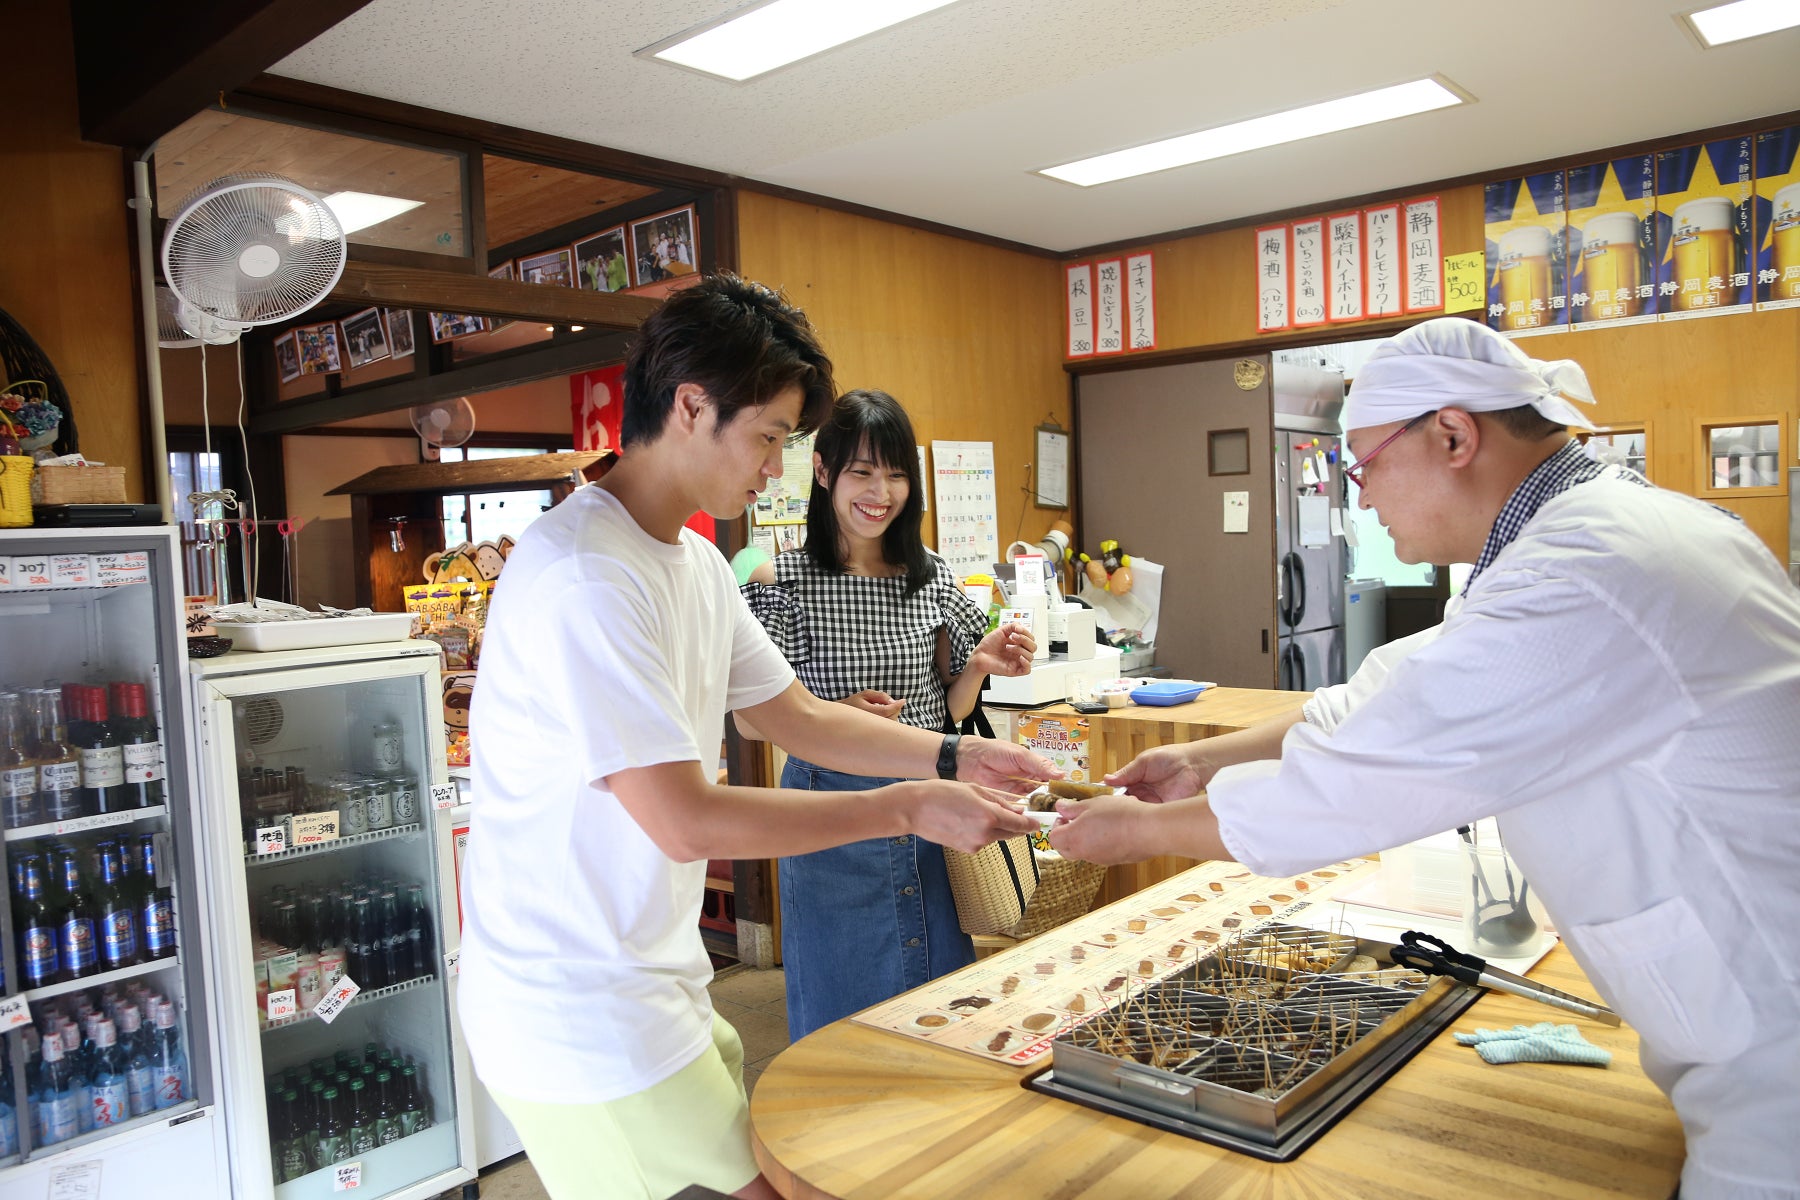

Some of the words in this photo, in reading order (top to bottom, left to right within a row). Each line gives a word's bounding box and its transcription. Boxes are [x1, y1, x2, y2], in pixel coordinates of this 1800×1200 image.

[1263, 237, 1280, 278] 梅酒
[1409, 212, 1436, 306] 静岡麦酒
[1450, 281, 1478, 300] 500
[1571, 284, 1656, 308] 静岡麦酒
[1660, 272, 1751, 297] 静岡麦酒
[1071, 279, 1088, 327] 枝豆
[1132, 261, 1148, 340] チキンライス
[1488, 295, 1567, 318] 静岡麦酒
[1073, 340, 1091, 352] 380
[430, 602, 456, 612] SABA
[1038, 729, 1068, 741] みらい飯
[260, 829, 283, 842] 地酒
